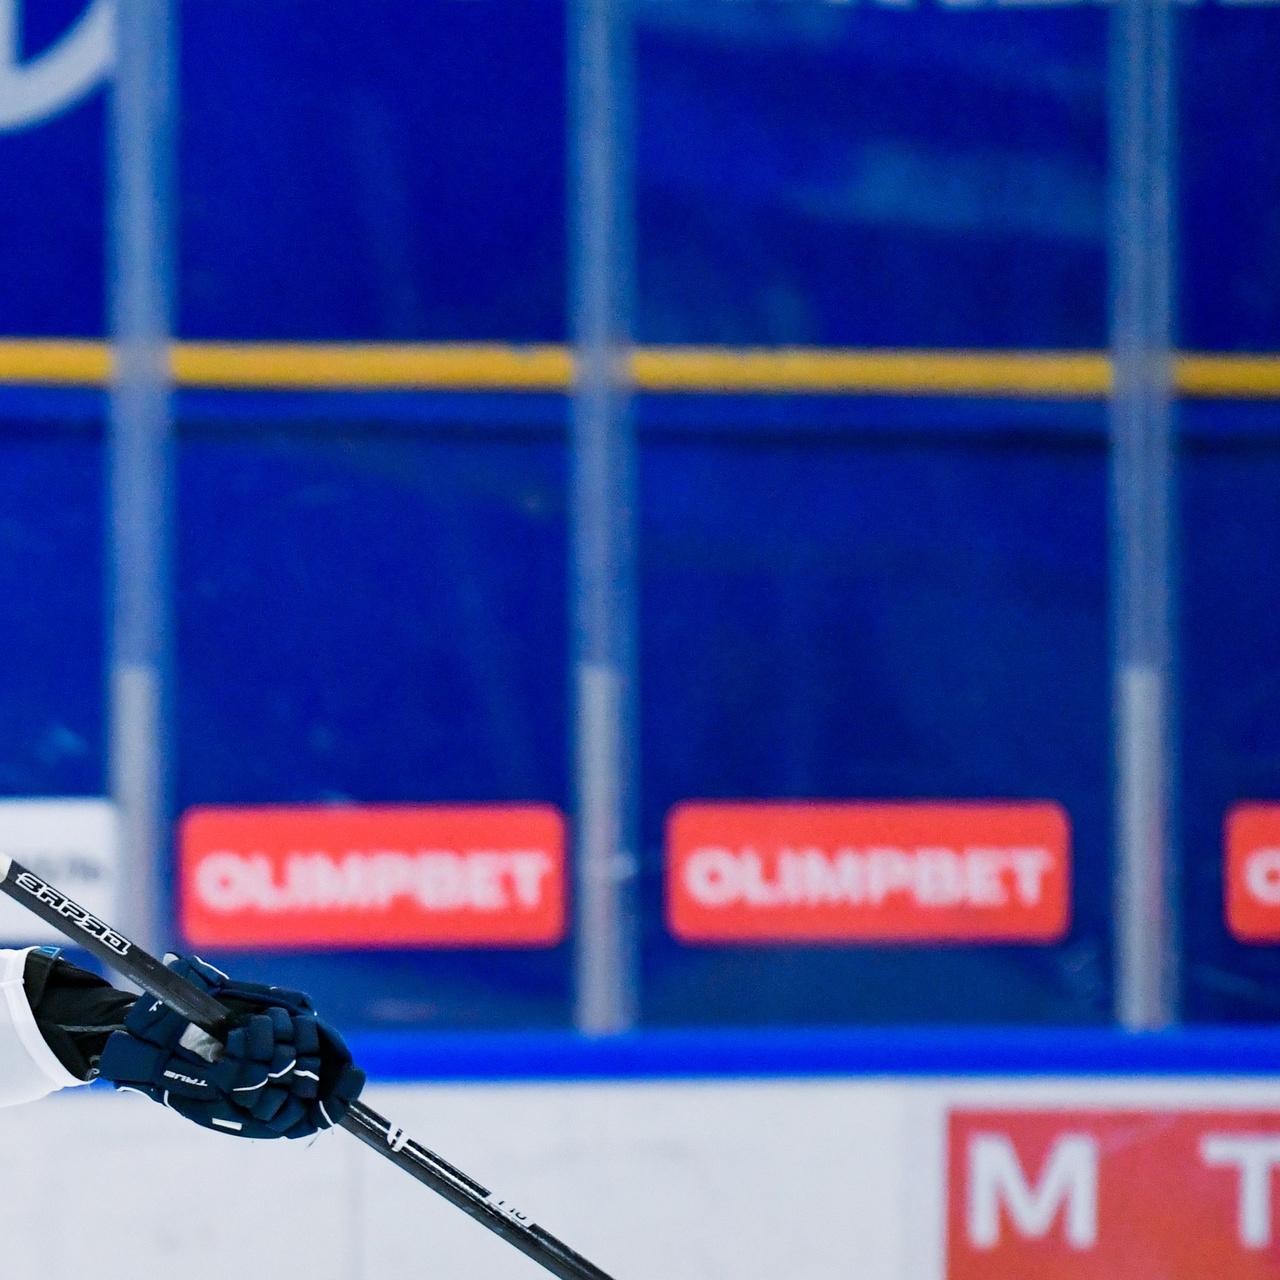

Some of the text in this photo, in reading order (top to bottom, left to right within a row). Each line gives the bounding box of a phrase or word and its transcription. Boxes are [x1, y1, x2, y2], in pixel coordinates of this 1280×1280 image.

[195, 850, 554, 912] OLIMPBET
[682, 846, 1055, 908] OLIMPBET
[163, 1069, 208, 1087] TRUE
